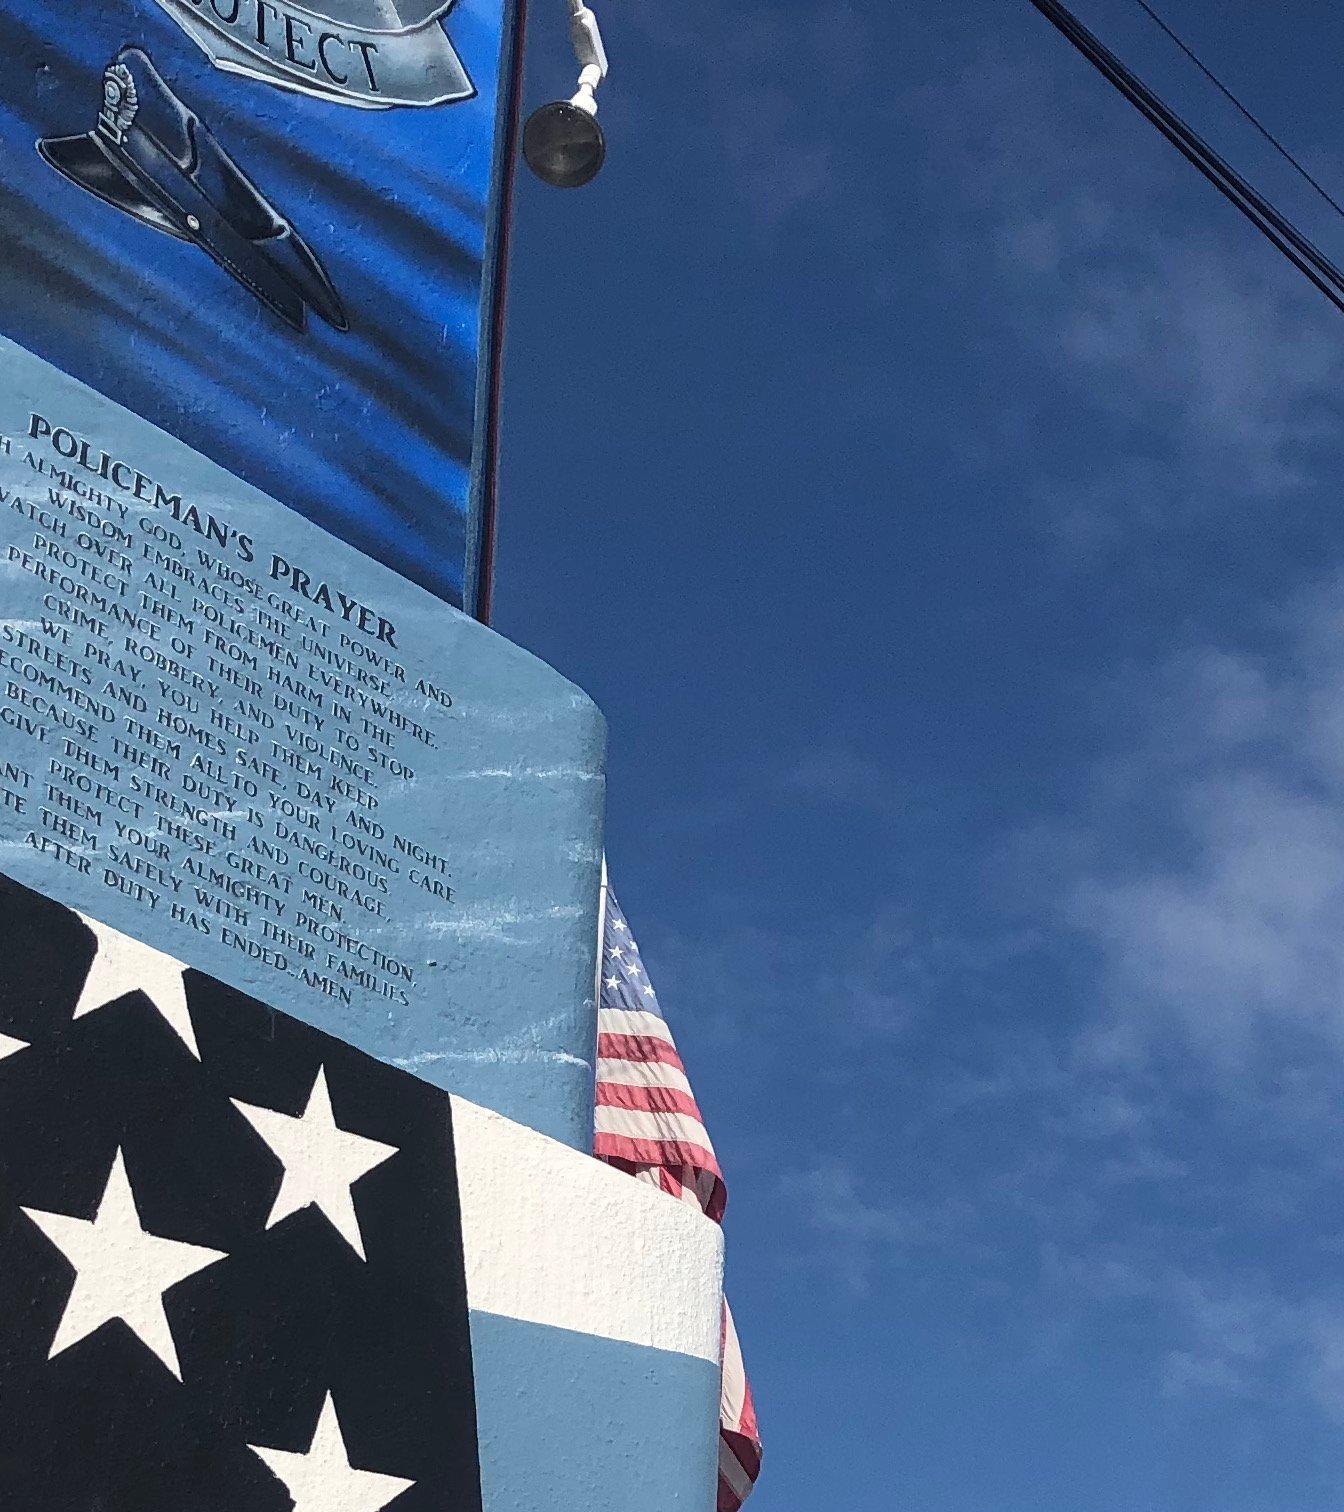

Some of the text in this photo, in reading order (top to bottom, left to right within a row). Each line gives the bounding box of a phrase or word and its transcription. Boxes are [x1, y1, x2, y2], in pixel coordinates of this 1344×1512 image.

[192, 0, 380, 92] OTECT
[23, 451, 129, 521] ALMIGHTY
[138, 517, 186, 558] GOD,
[197, 549, 265, 601] WHOSE
[265, 591, 331, 638] GREAT
[340, 633, 406, 684] POWER
[415, 679, 453, 708] AND
[28, 413, 398, 650] POLICEMAN'S PRAYER
[48, 487, 133, 551] WISDOM
[142, 542, 246, 615] EMBRACES
[253, 607, 291, 641] THE
[8, 545, 414, 783] PERFORMANCE OF THEIR DUTY TO STOP
[33, 533, 395, 750] PROTECT THEM FROM HARM IN THE
[40, 616, 379, 812] WE PRAY, YOU HELP THEM KEEP
[44, 591, 378, 790] CRIME, ROBBERY, AND VIOLENCE.
[75, 533, 133, 580] OVER
[142, 572, 182, 605] ALL
[192, 597, 299, 670] POLICEMEN
[308, 662, 438, 750] EVERYWHERE.
[2, 624, 92, 687] STREETS
[102, 681, 148, 713] AND
[156, 707, 229, 757] HOMES
[235, 746, 287, 791] SAFE,
[296, 781, 336, 814] DAY
[345, 809, 385, 840] AND
[393, 834, 452, 878] NIGHT.
[4, 680, 99, 744] BECAUSE
[110, 736, 171, 781] THEIR
[181, 774, 238, 813] DUTY
[247, 806, 265, 829] IS
[48, 759, 347, 925] PROTECT THESE GREAT MEN.
[63, 738, 120, 783] THEM
[130, 775, 237, 842] STRENGTH
[246, 835, 289, 866] AND
[298, 861, 392, 923] COURAGE,
[124, 717, 183, 762] THEM
[188, 752, 230, 789] ALL
[231, 773, 258, 801] TO
[268, 791, 321, 834] YOUR
[331, 825, 400, 874] LOVING
[408, 869, 456, 905] CARE
[24, 831, 92, 876] AFTER
[103, 867, 161, 910] DUTY
[169, 899, 211, 936] HAS
[39, 807, 99, 852] THEM
[108, 844, 183, 893] SAFELY
[192, 884, 251, 927] WITH
[259, 919, 318, 961] THEIR
[324, 953, 409, 1007] FAMILIES
[43, 782, 102, 827] THEM
[114, 819, 171, 863] YOUR
[180, 856, 286, 917] ALMIGHTY
[295, 911, 417, 988] PROTECTION,
